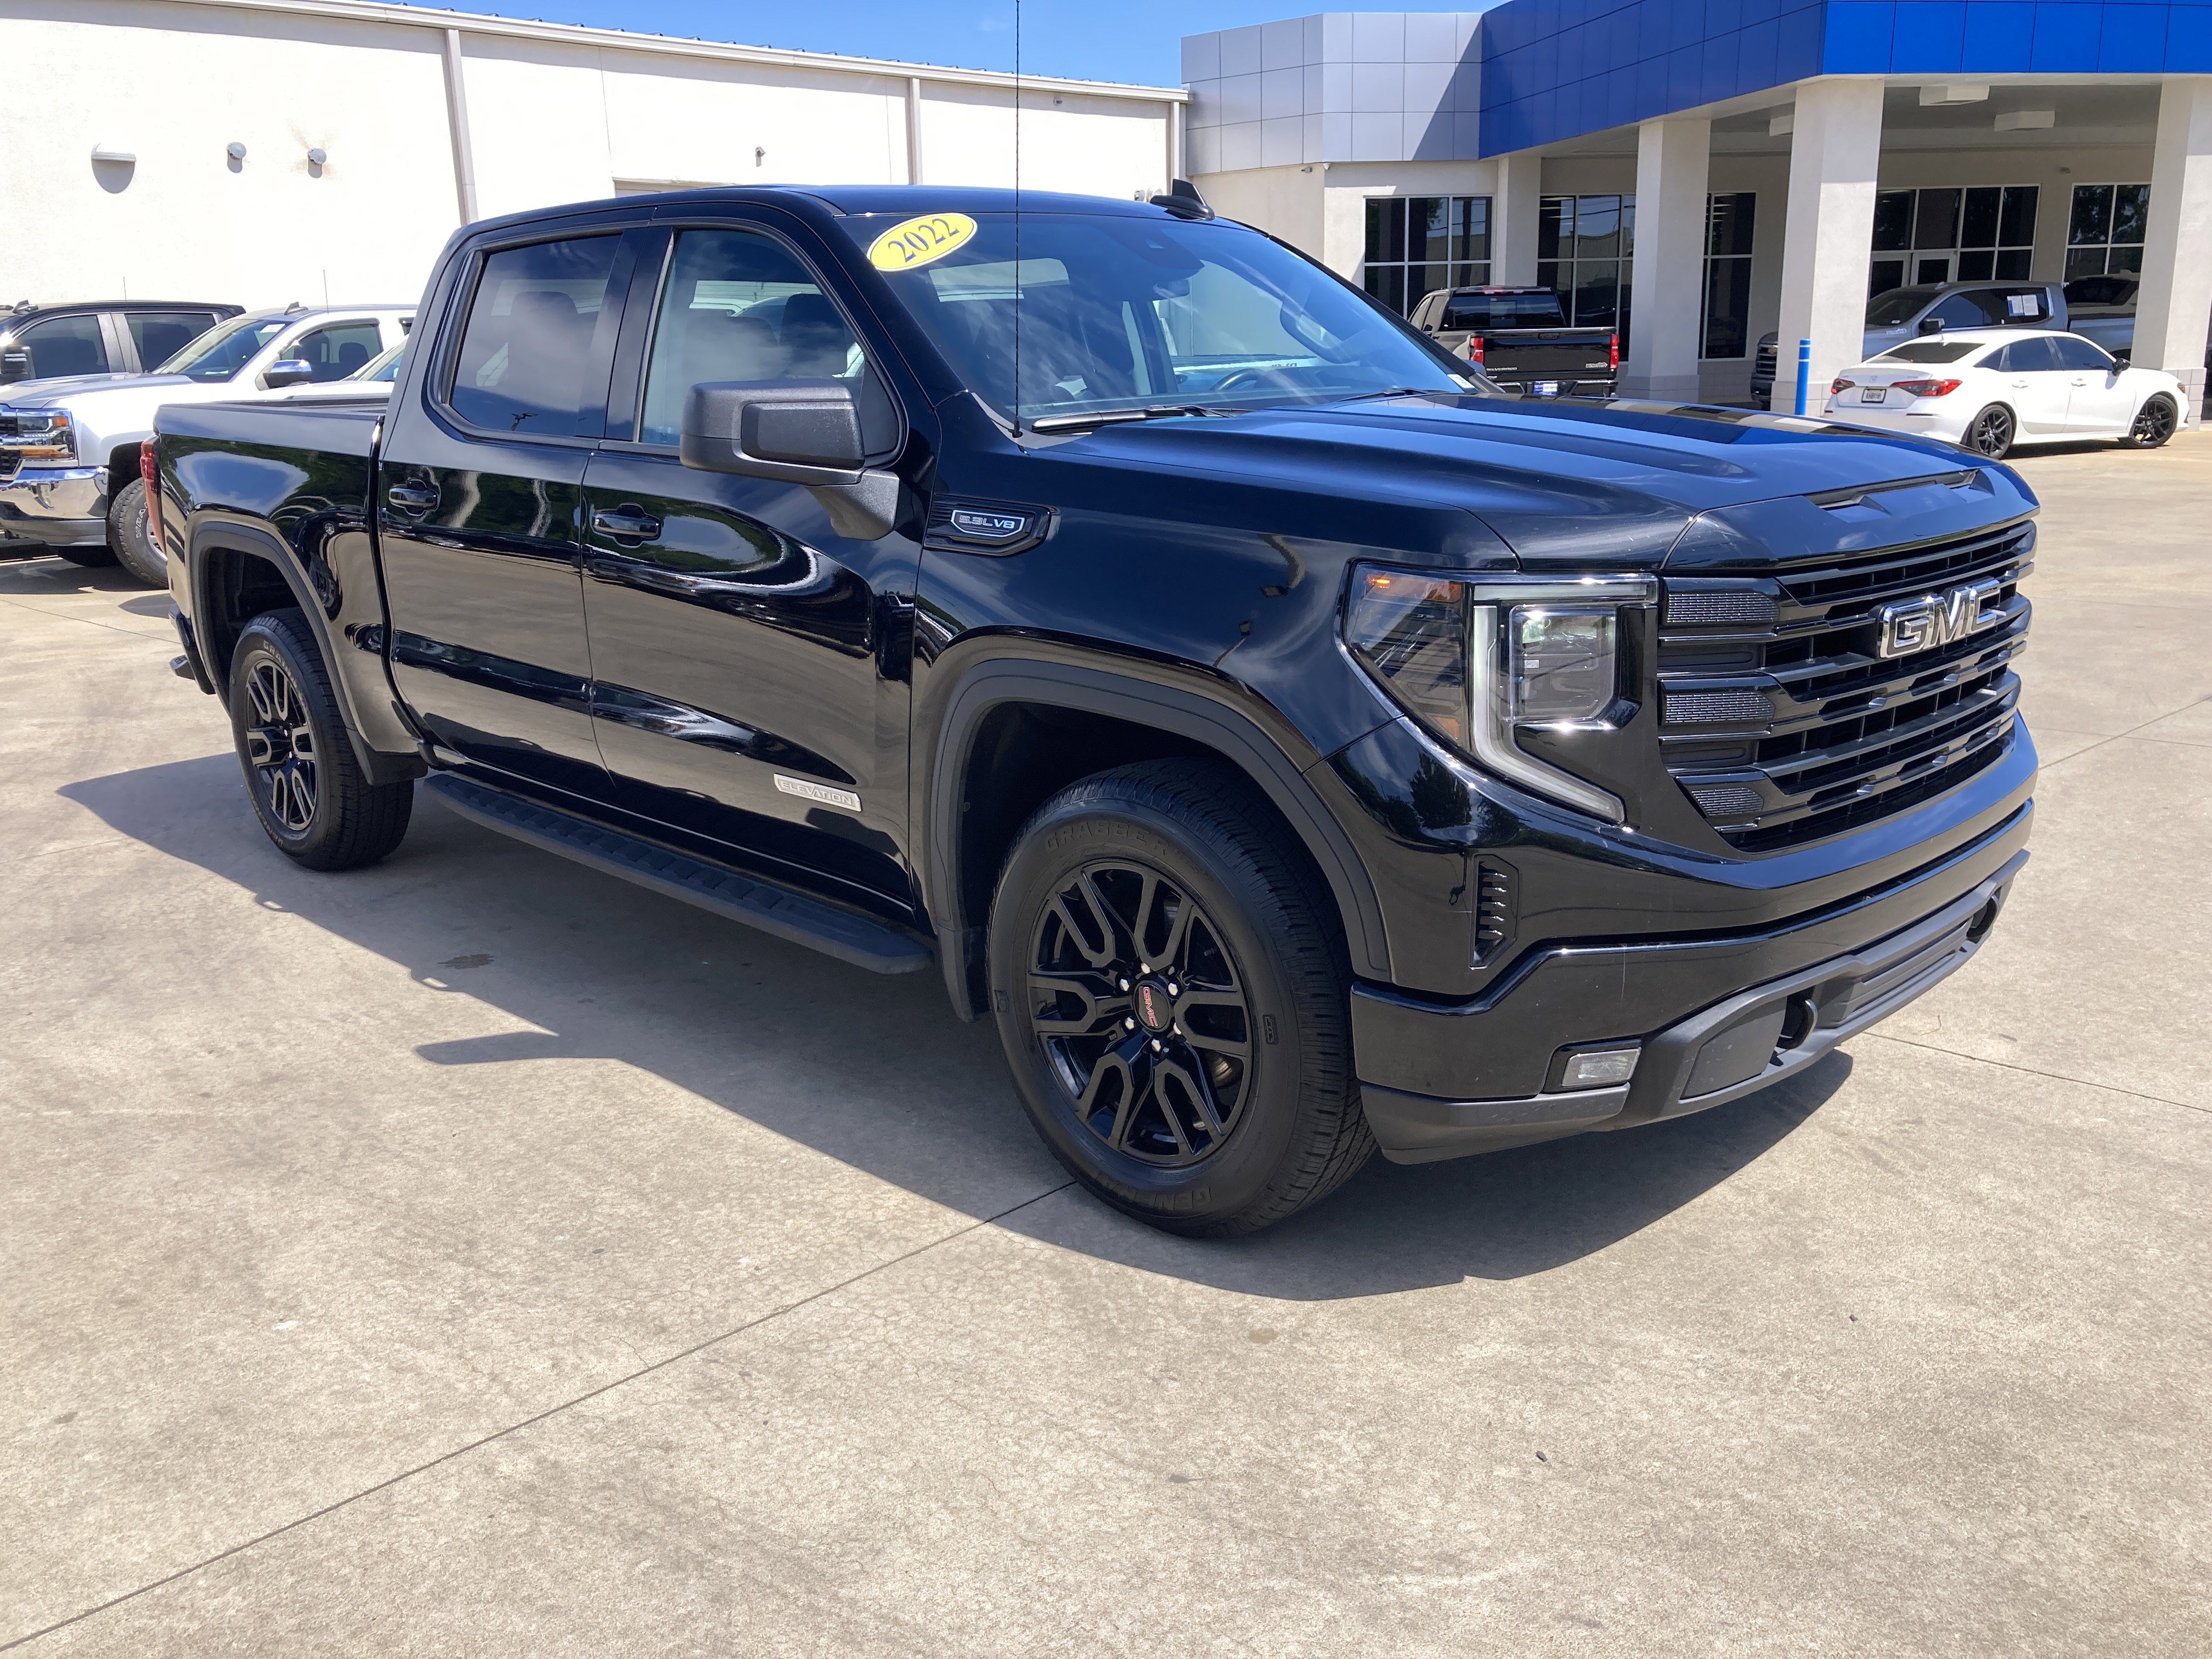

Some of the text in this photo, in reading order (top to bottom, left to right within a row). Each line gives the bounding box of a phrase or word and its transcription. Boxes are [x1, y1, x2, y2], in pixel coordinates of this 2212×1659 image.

[888, 218, 960, 263] 2022
[1880, 579, 2001, 658] GMC
[781, 780, 853, 805] ELEVATION
[1143, 986, 1158, 1027] GMC
